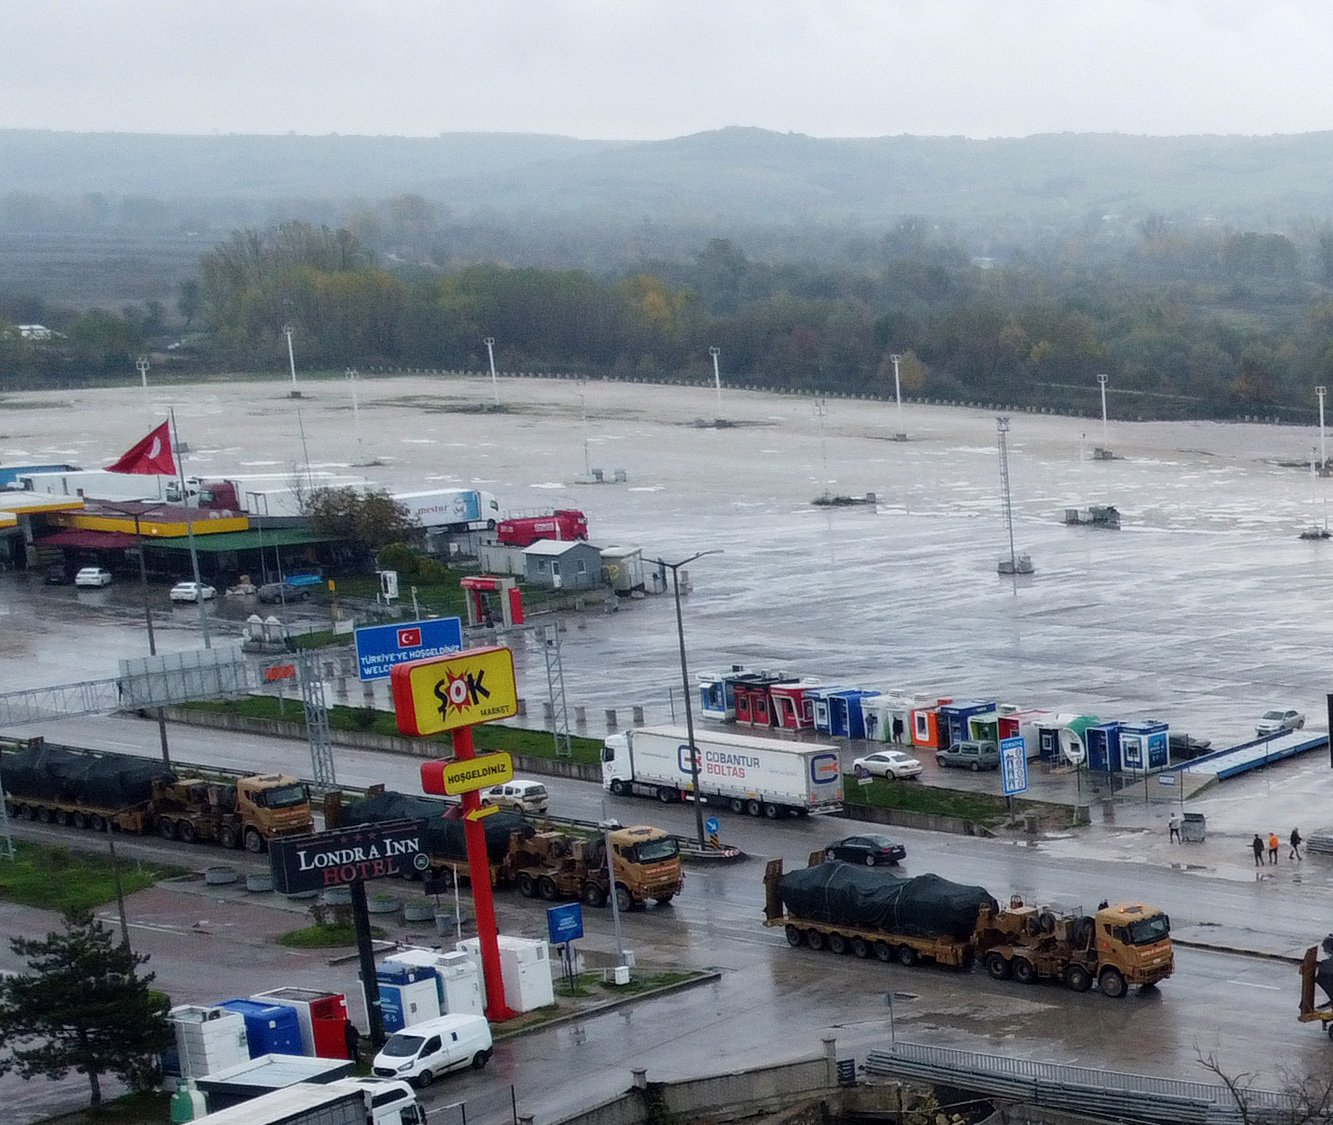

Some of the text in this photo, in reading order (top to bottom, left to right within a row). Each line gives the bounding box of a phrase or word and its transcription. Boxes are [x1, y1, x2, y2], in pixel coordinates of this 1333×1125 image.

[434, 668, 491, 723] ŞOK
[480, 704, 510, 717] MARKET
[705, 750, 760, 769] COBANTUR
[447, 763, 507, 785] HOŞGELDİNİZ
[296, 838, 420, 871] LONDRA INN
[323, 858, 400, 887] HOTEL
